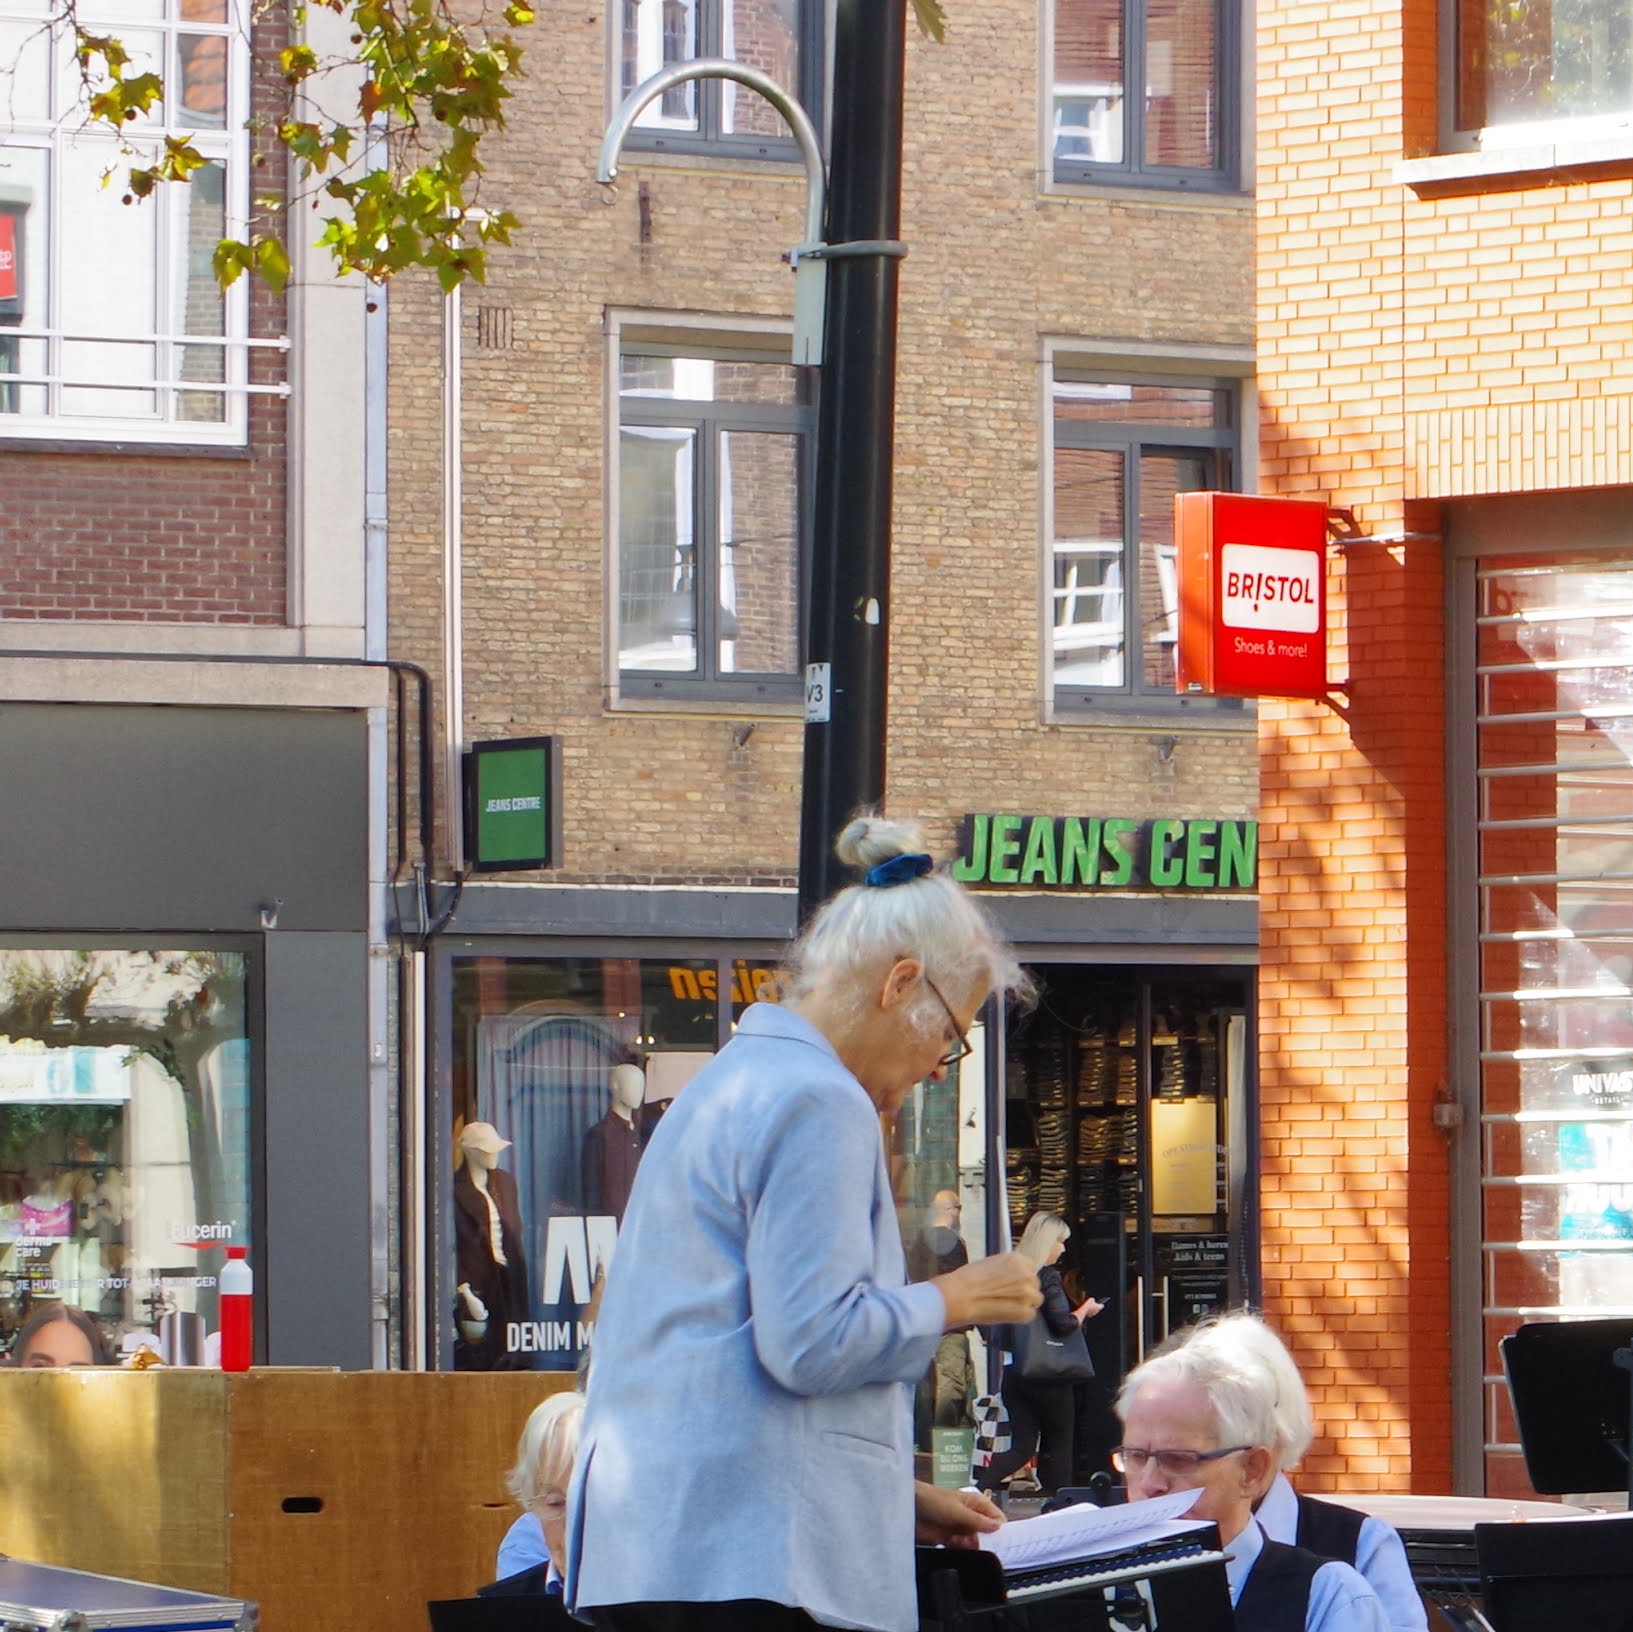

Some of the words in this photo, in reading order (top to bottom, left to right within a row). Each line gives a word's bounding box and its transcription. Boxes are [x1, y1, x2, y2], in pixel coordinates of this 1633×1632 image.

[1234, 637, 1265, 656] Shoes
[1267, 640, 1276, 655] &
[1278, 643, 1308, 658] more!
[486, 799, 511, 812] JEANS
[512, 796, 541, 810] CENTRE
[952, 814, 1136, 886] JEANS
[1149, 818, 1258, 887] CEN
[507, 1321, 571, 1352] DENIM
